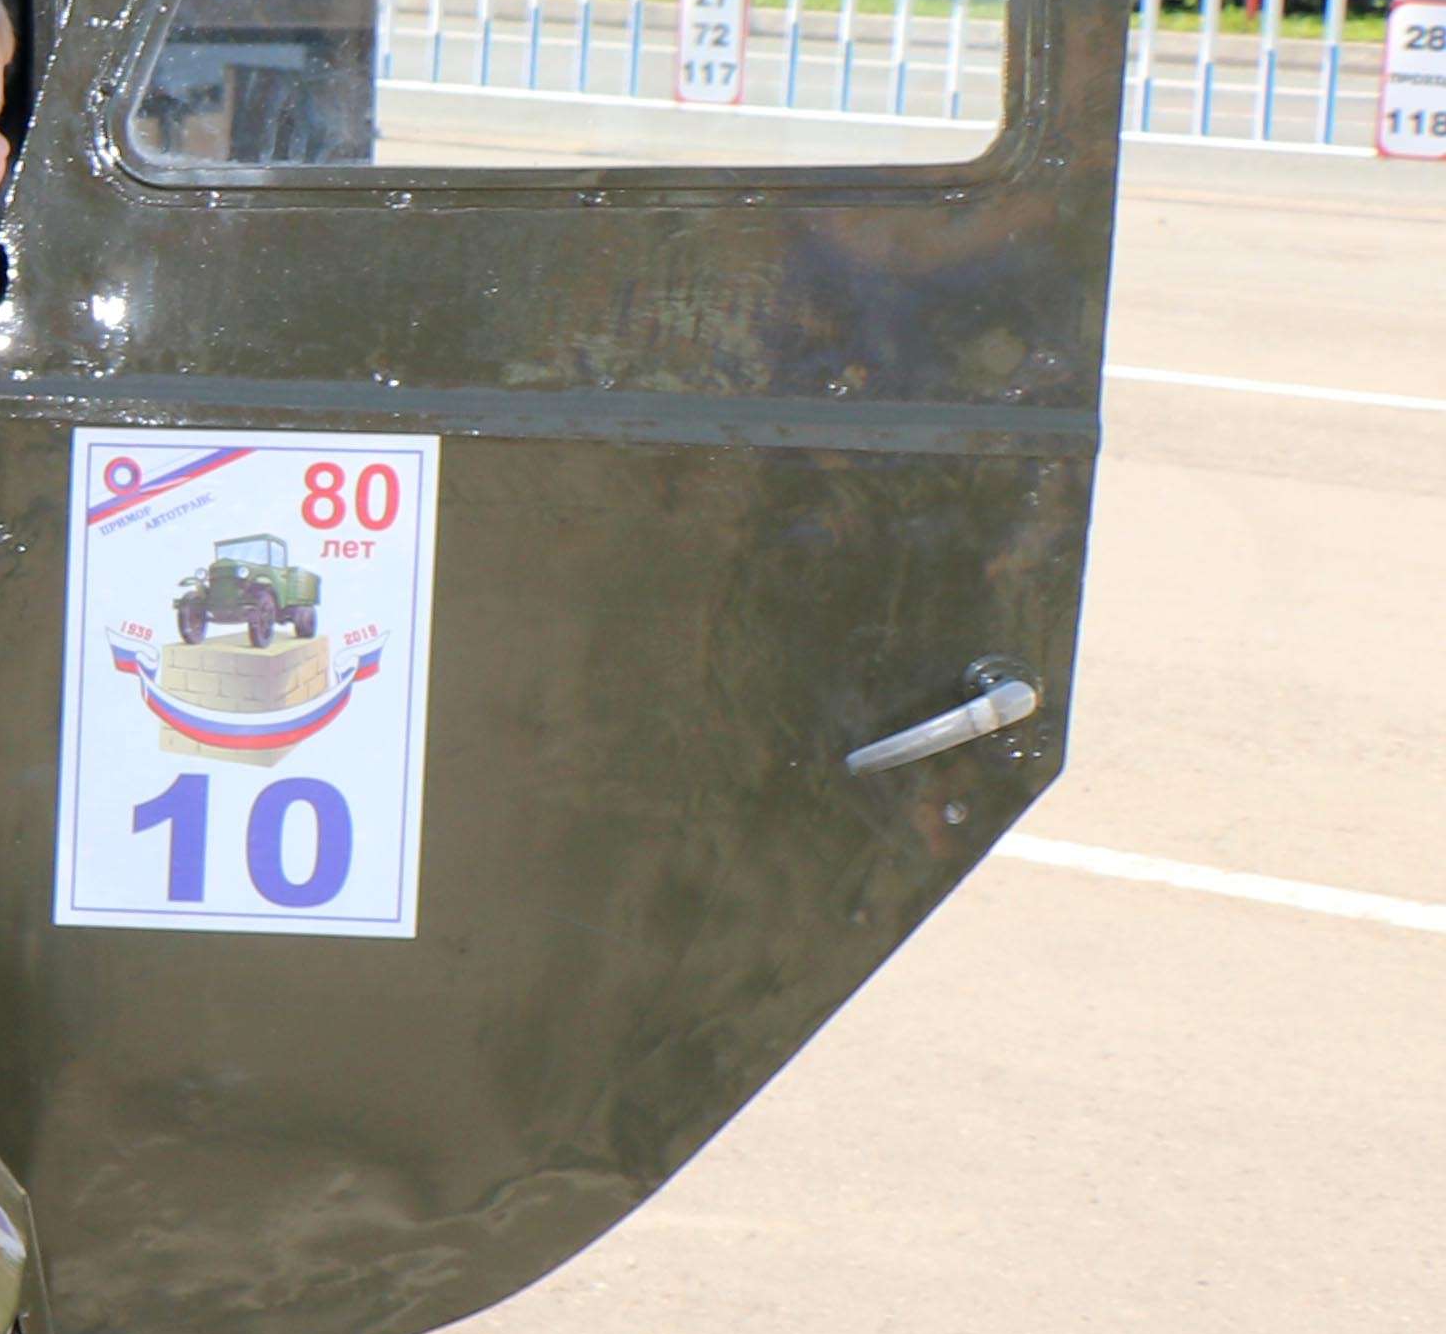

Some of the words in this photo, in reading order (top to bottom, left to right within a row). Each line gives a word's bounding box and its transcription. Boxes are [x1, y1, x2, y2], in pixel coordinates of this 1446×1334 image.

[693, 22, 732, 48] 72
[683, 60, 737, 86] 117
[300, 461, 401, 532] 80
[319, 536, 376, 560] лет
[120, 620, 154, 642] 1939
[132, 772, 354, 909] 10
